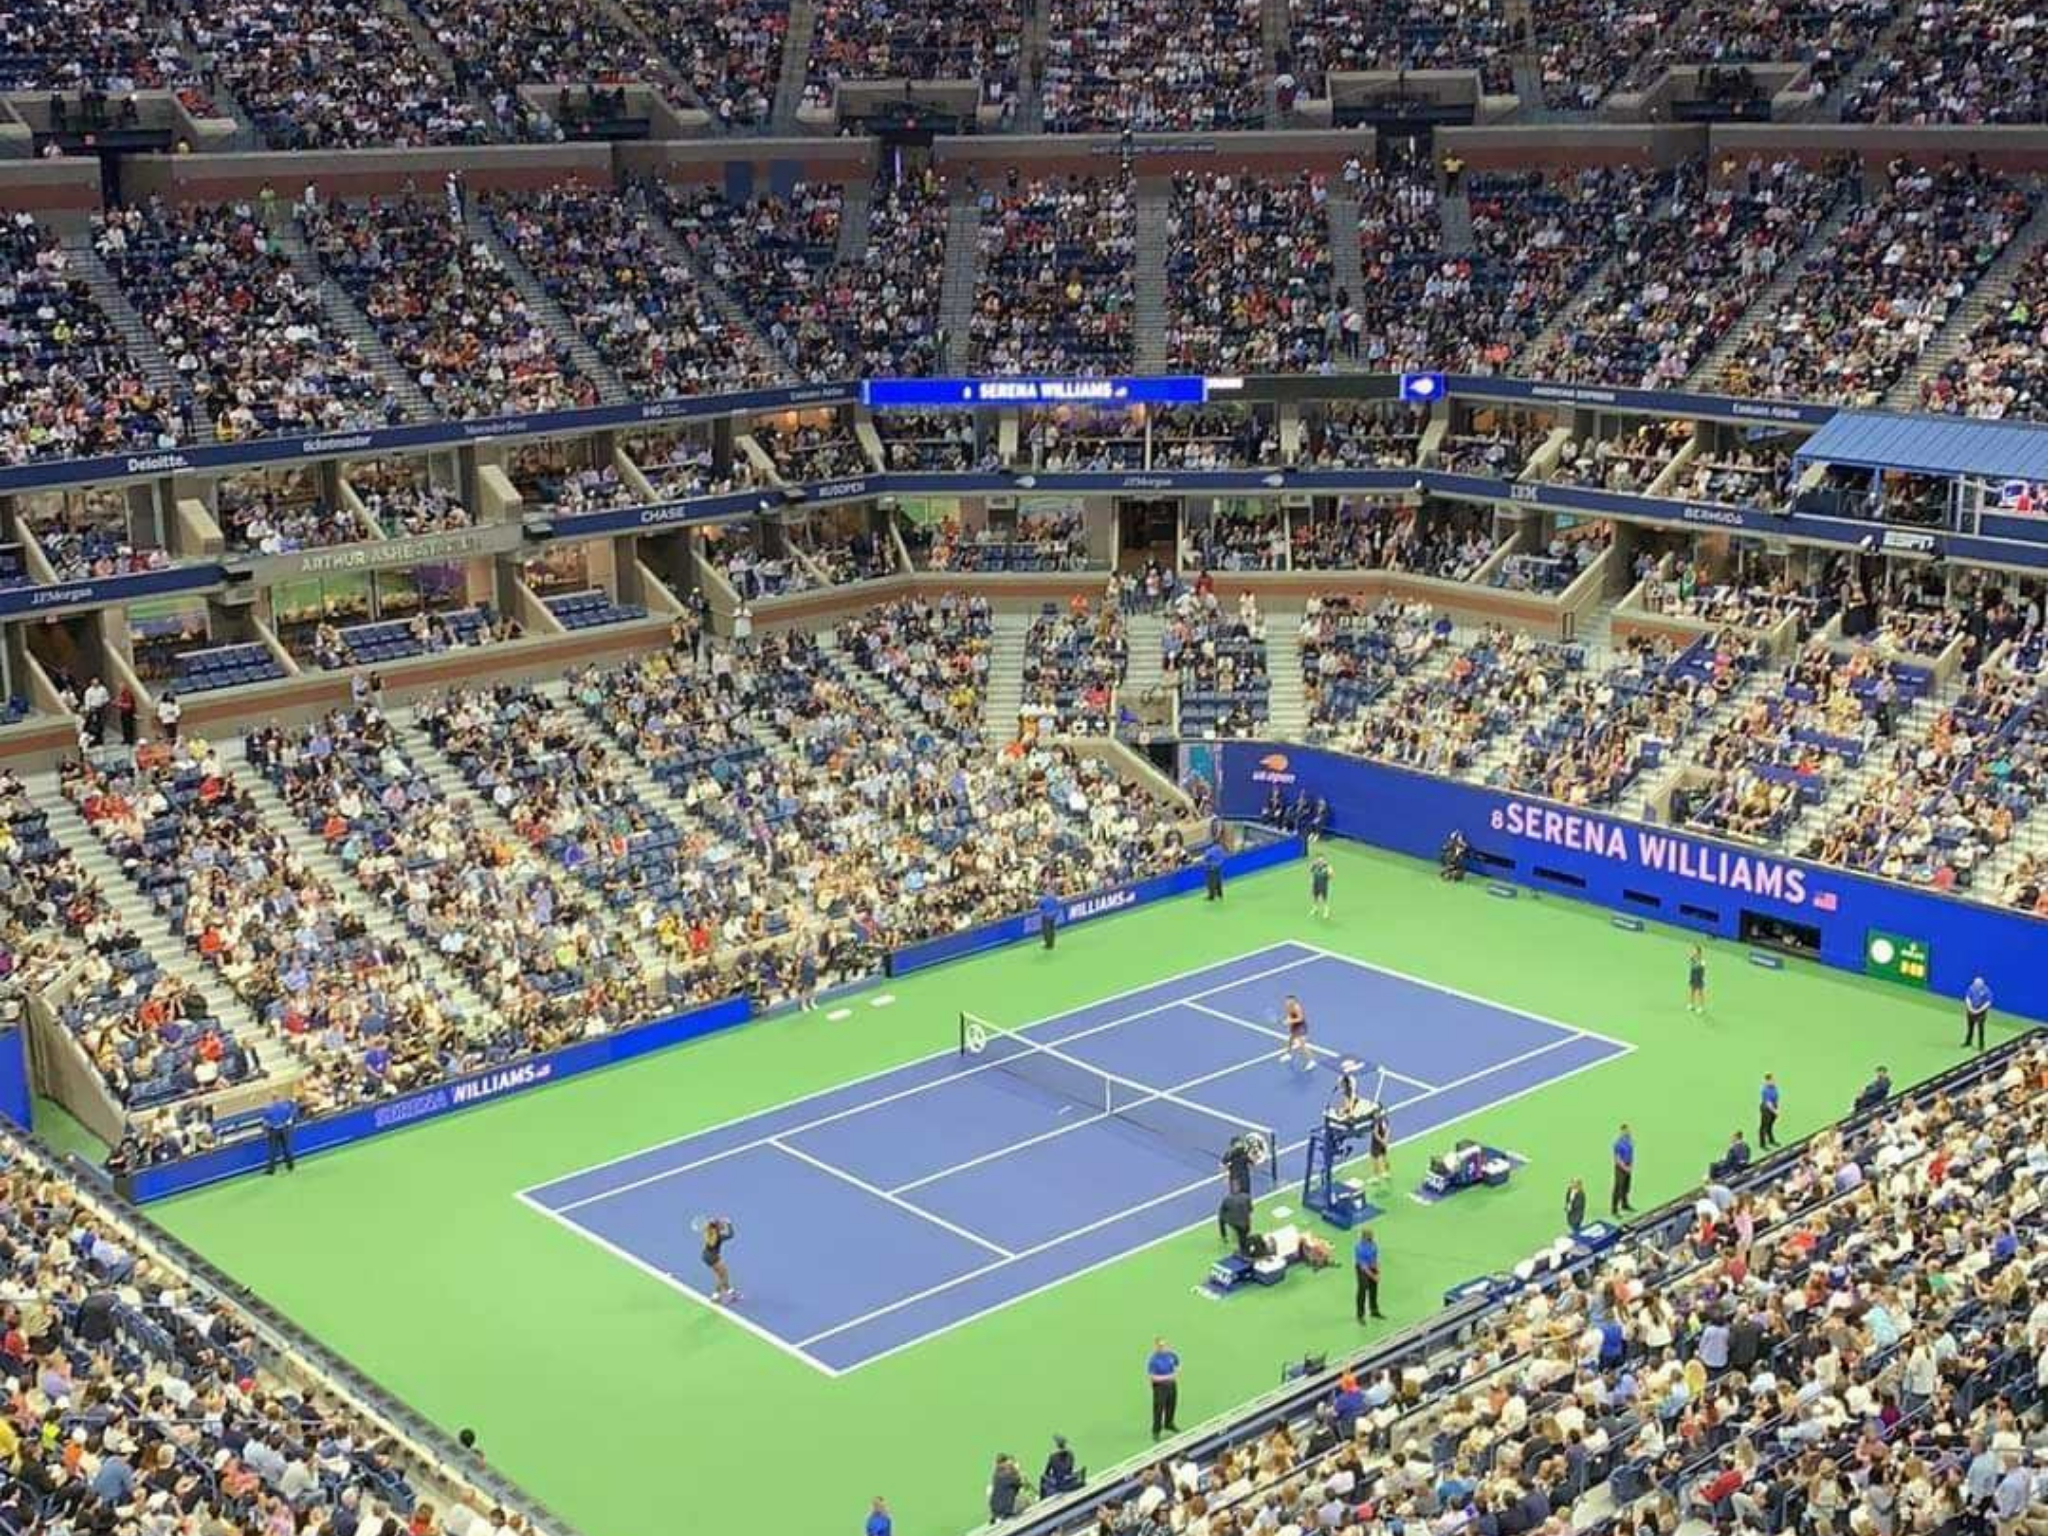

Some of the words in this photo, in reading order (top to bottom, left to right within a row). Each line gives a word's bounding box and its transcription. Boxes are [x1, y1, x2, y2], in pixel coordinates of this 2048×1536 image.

[980, 382, 1037, 399] SERENA
[1040, 381, 1112, 398] WILLIAMS
[303, 435, 371, 452] ticketmaster
[1510, 485, 1537, 501] IBM
[641, 506, 685, 522] CHASE
[1684, 507, 1743, 524] BERMUDA
[1883, 530, 1935, 550] ESPN
[302, 551, 366, 572] ARTHUR
[1491, 808, 1502, 830] 8
[1506, 802, 1628, 861] SERENA
[1639, 832, 1806, 904] WILLIAMS
[1068, 890, 1124, 920] WILLIAMS
[453, 1064, 534, 1104] WILLIAMS
